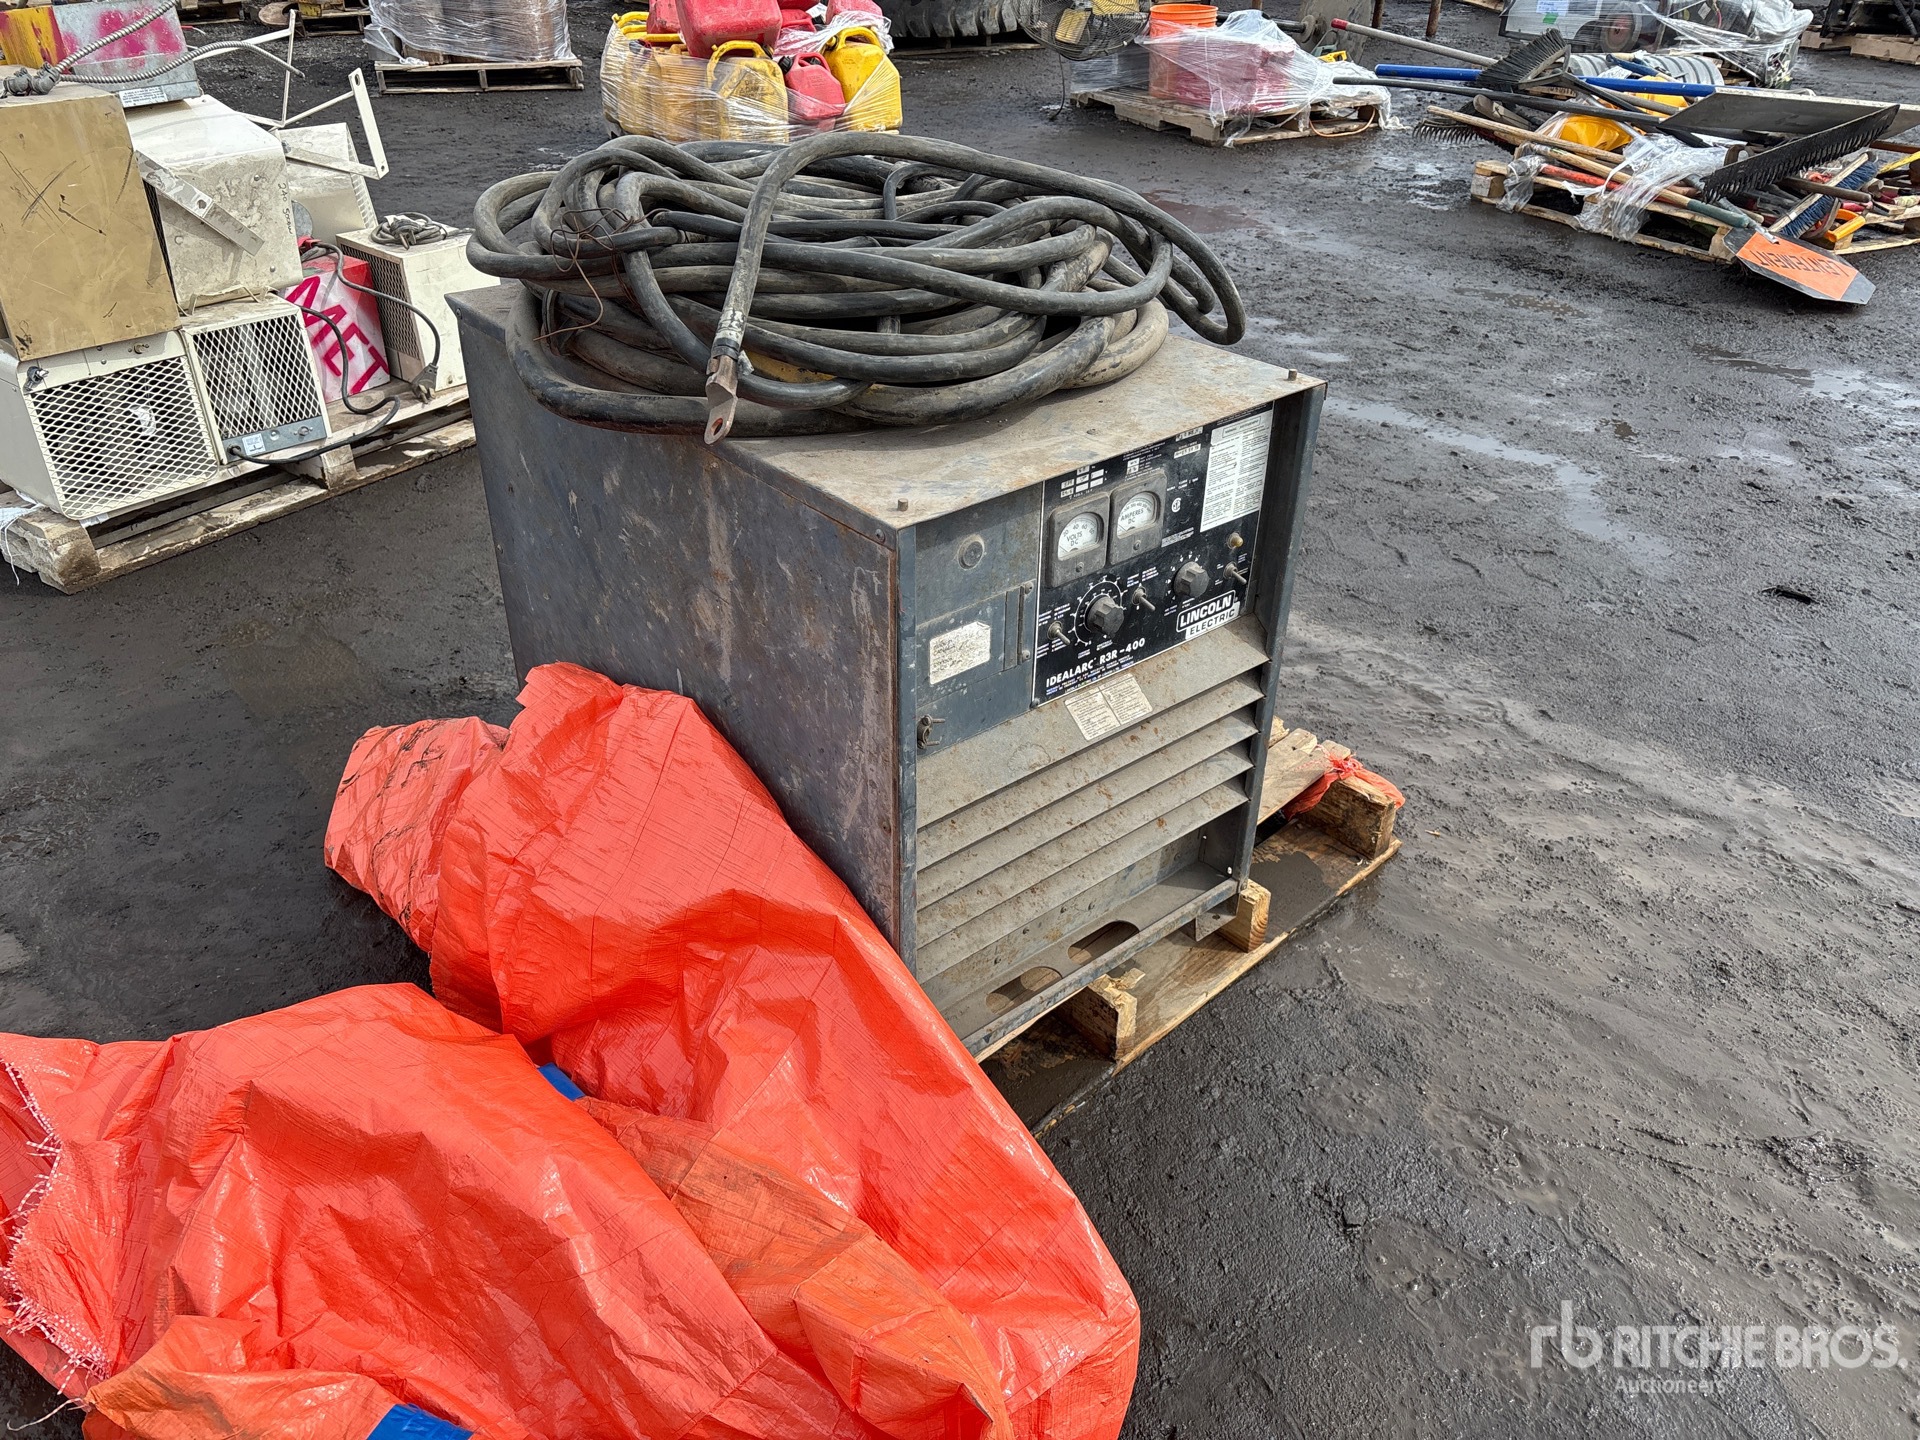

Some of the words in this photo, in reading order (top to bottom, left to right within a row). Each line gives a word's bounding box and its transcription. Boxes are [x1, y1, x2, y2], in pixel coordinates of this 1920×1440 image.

[1750, 250, 1850, 278] LENTEMENT
[1066, 531, 1083, 542] VOLTS
[1180, 595, 1232, 628] LINCOLN
[1190, 609, 1235, 636] ELECTRIC
[1046, 659, 1094, 688] IDEALARC
